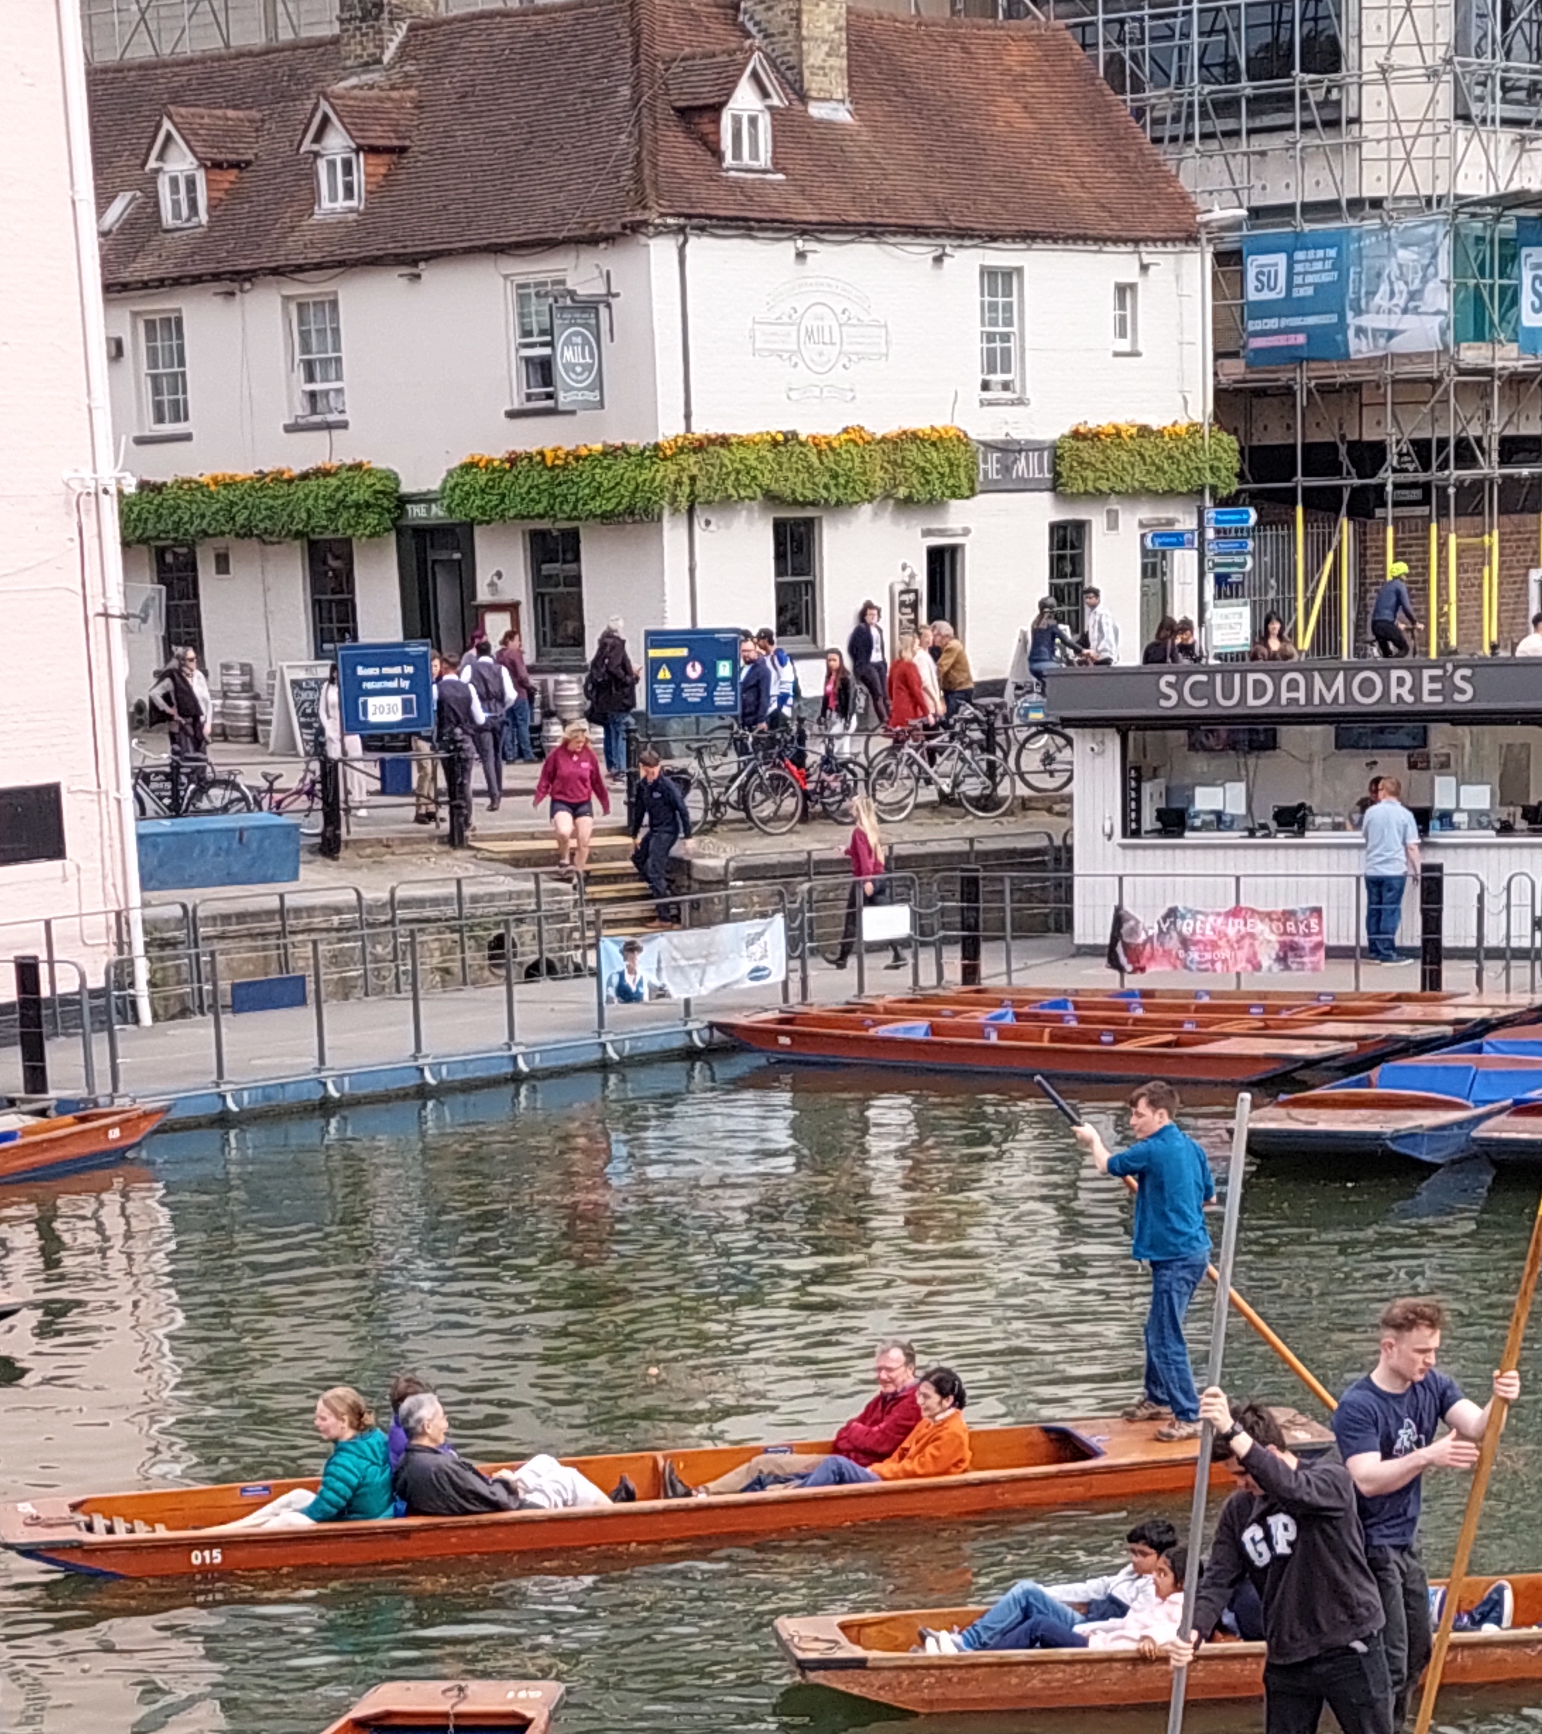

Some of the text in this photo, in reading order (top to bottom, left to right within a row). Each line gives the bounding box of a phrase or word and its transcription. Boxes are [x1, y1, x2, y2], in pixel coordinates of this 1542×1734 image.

[1254, 268, 1279, 294] SU
[803, 324, 837, 346] MILL
[563, 345, 594, 364] MILL
[978, 450, 1054, 482] HE MILL
[1158, 662, 1475, 708] SCUDAMORE'S
[190, 1548, 222, 1566] 015
